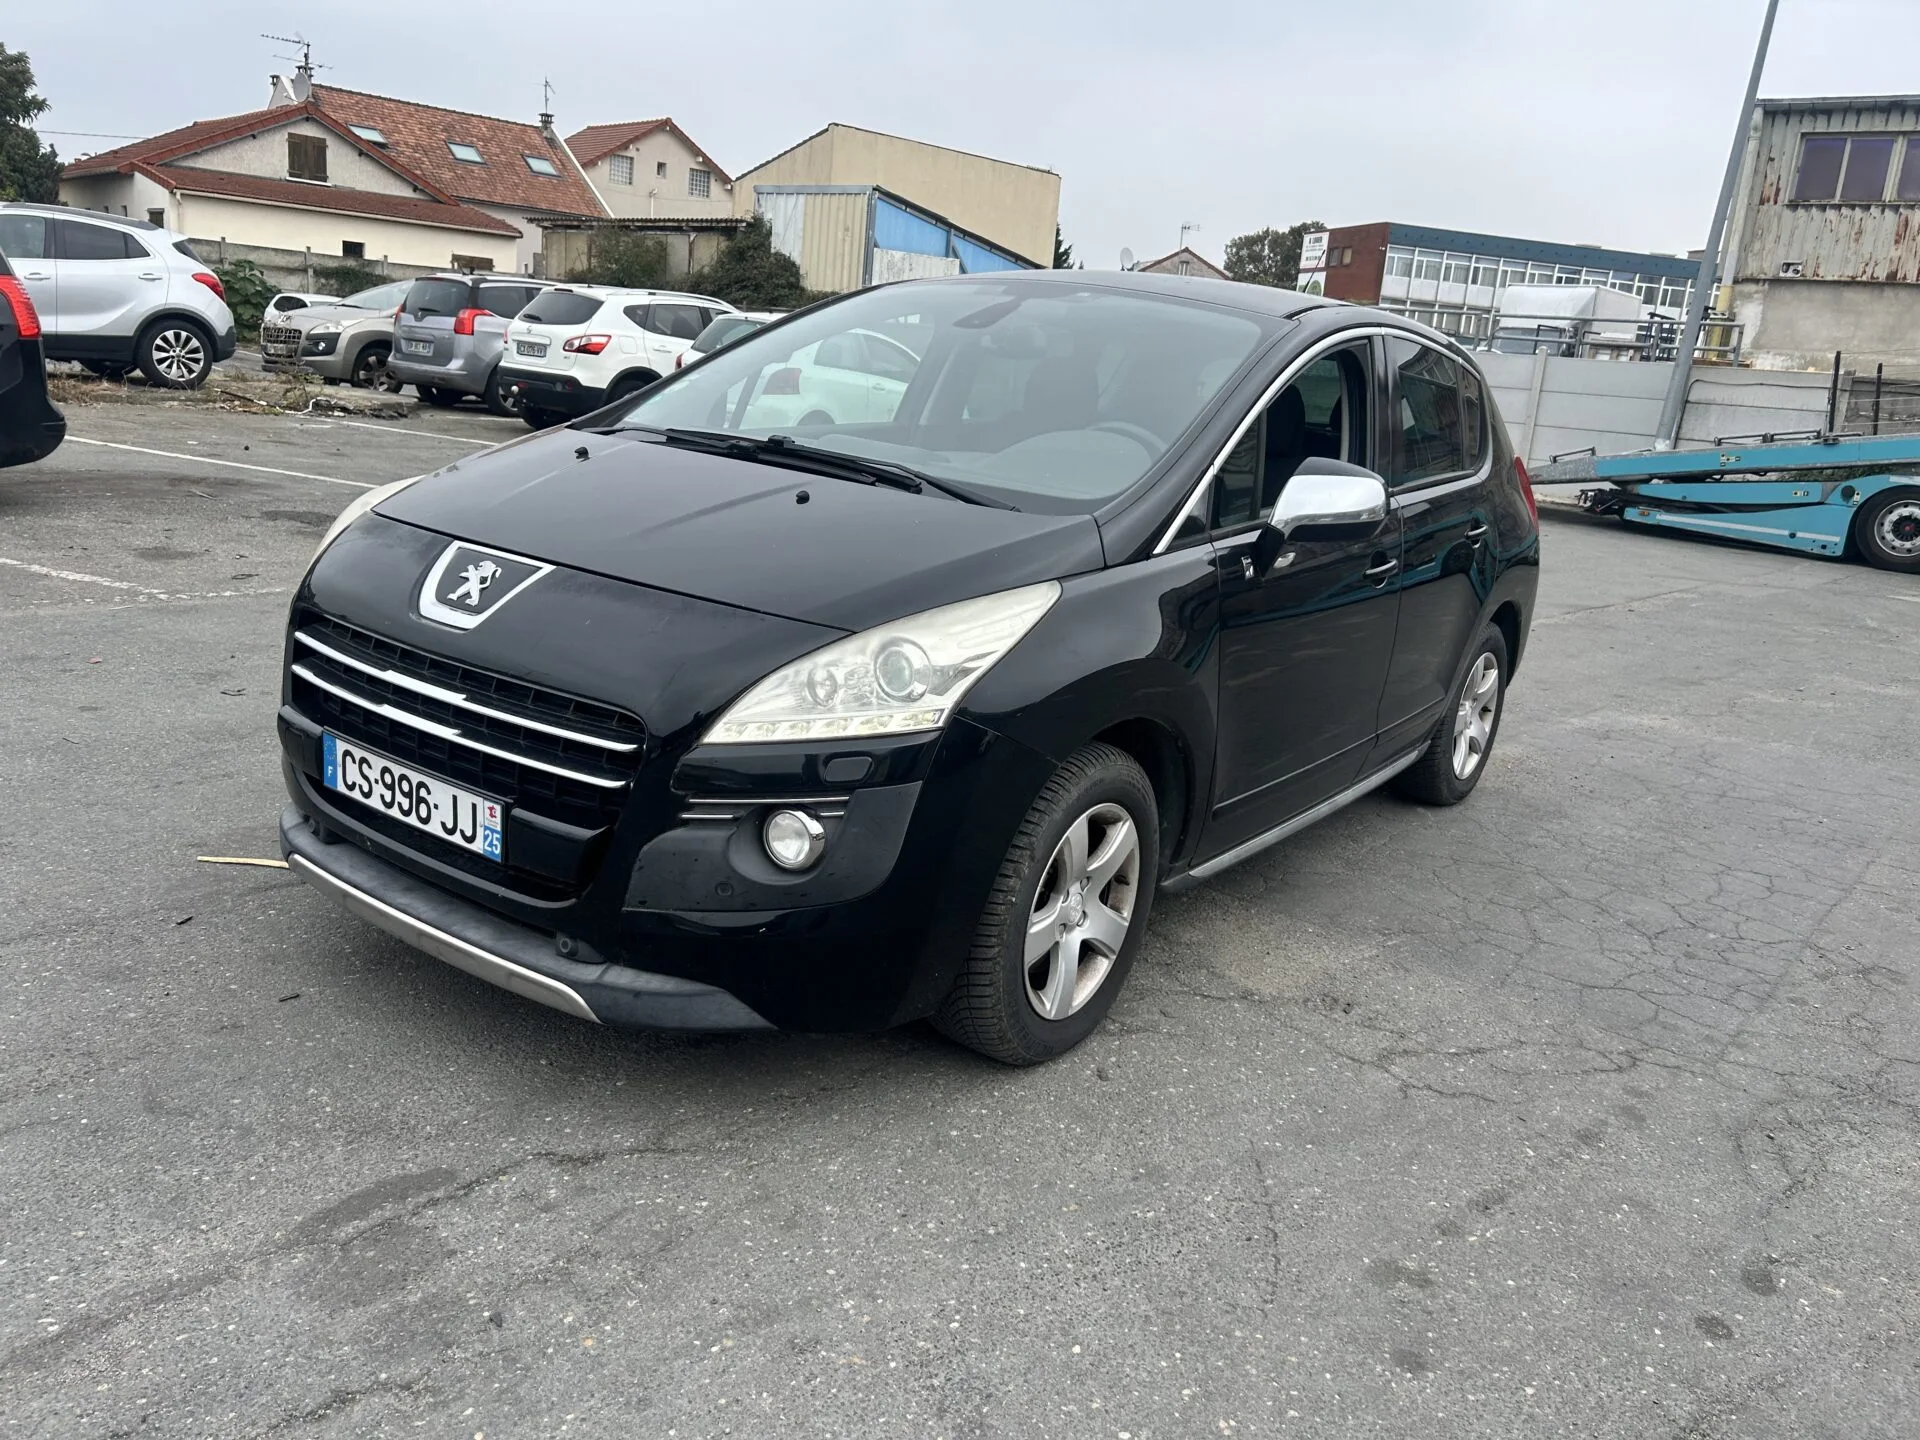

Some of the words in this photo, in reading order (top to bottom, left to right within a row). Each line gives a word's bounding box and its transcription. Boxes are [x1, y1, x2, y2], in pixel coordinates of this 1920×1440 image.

[328, 766, 333, 777] F
[341, 749, 478, 844] CS-996-JJ
[484, 829, 501, 855] 25
